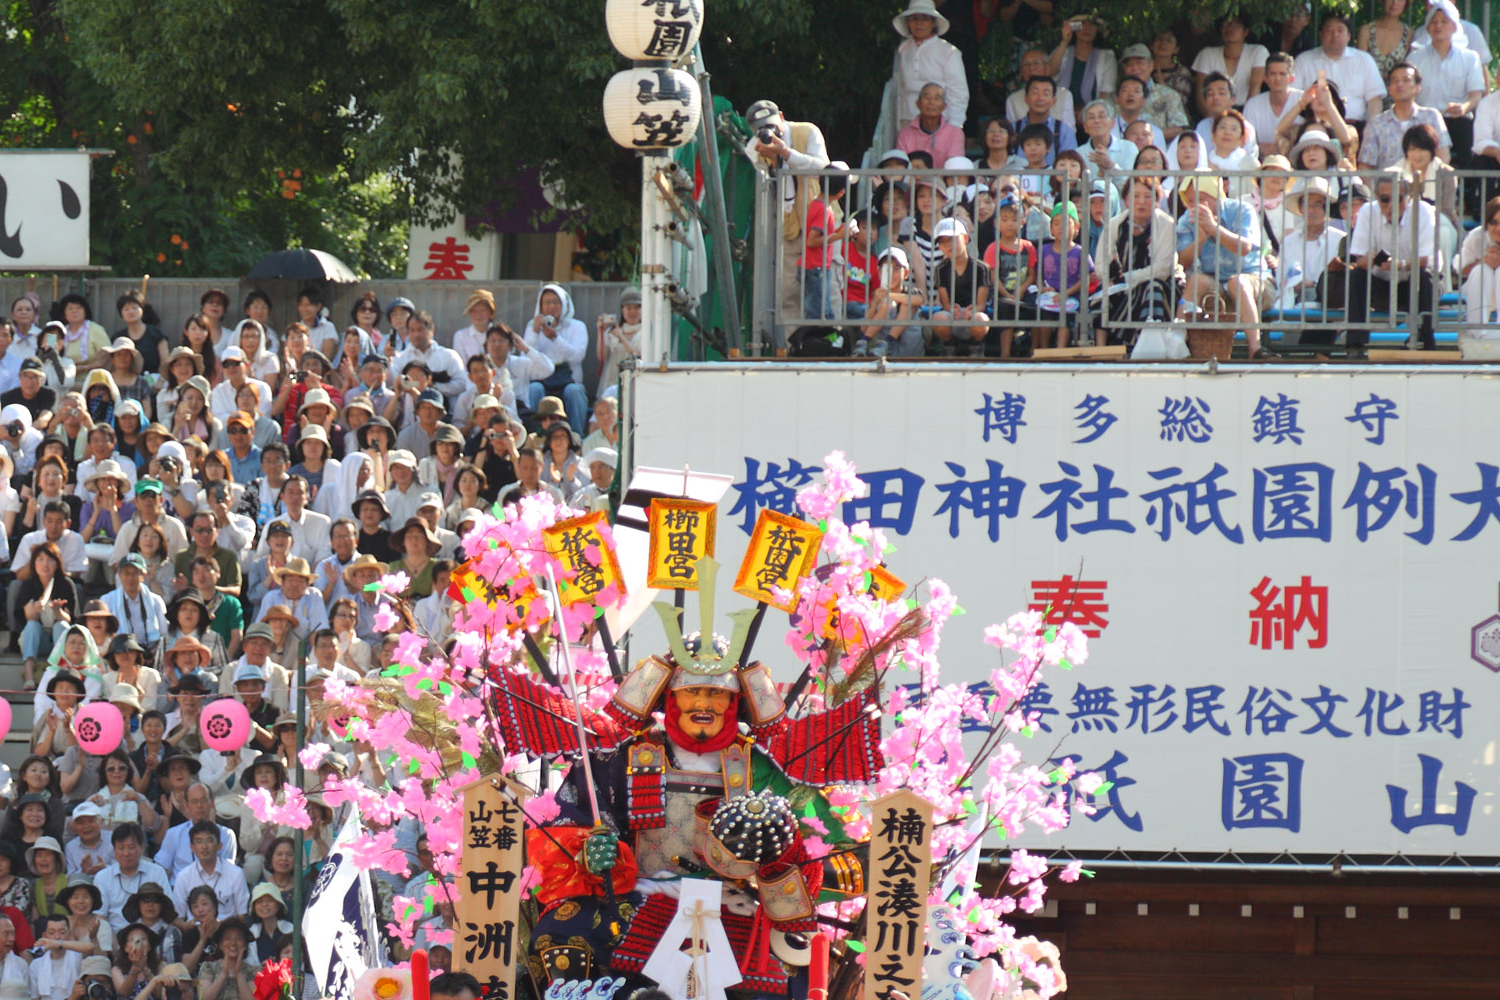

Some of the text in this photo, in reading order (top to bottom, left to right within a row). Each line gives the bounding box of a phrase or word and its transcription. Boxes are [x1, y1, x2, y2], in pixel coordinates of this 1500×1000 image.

[633, 69, 691, 146] 山笠
[974, 392, 1400, 446] 博多総鎮守
[662, 509, 700, 580] 櫛田宮
[1028, 574, 1329, 651] 奉納
[467, 800, 494, 850] 山笠
[492, 800, 519, 851] 七番
